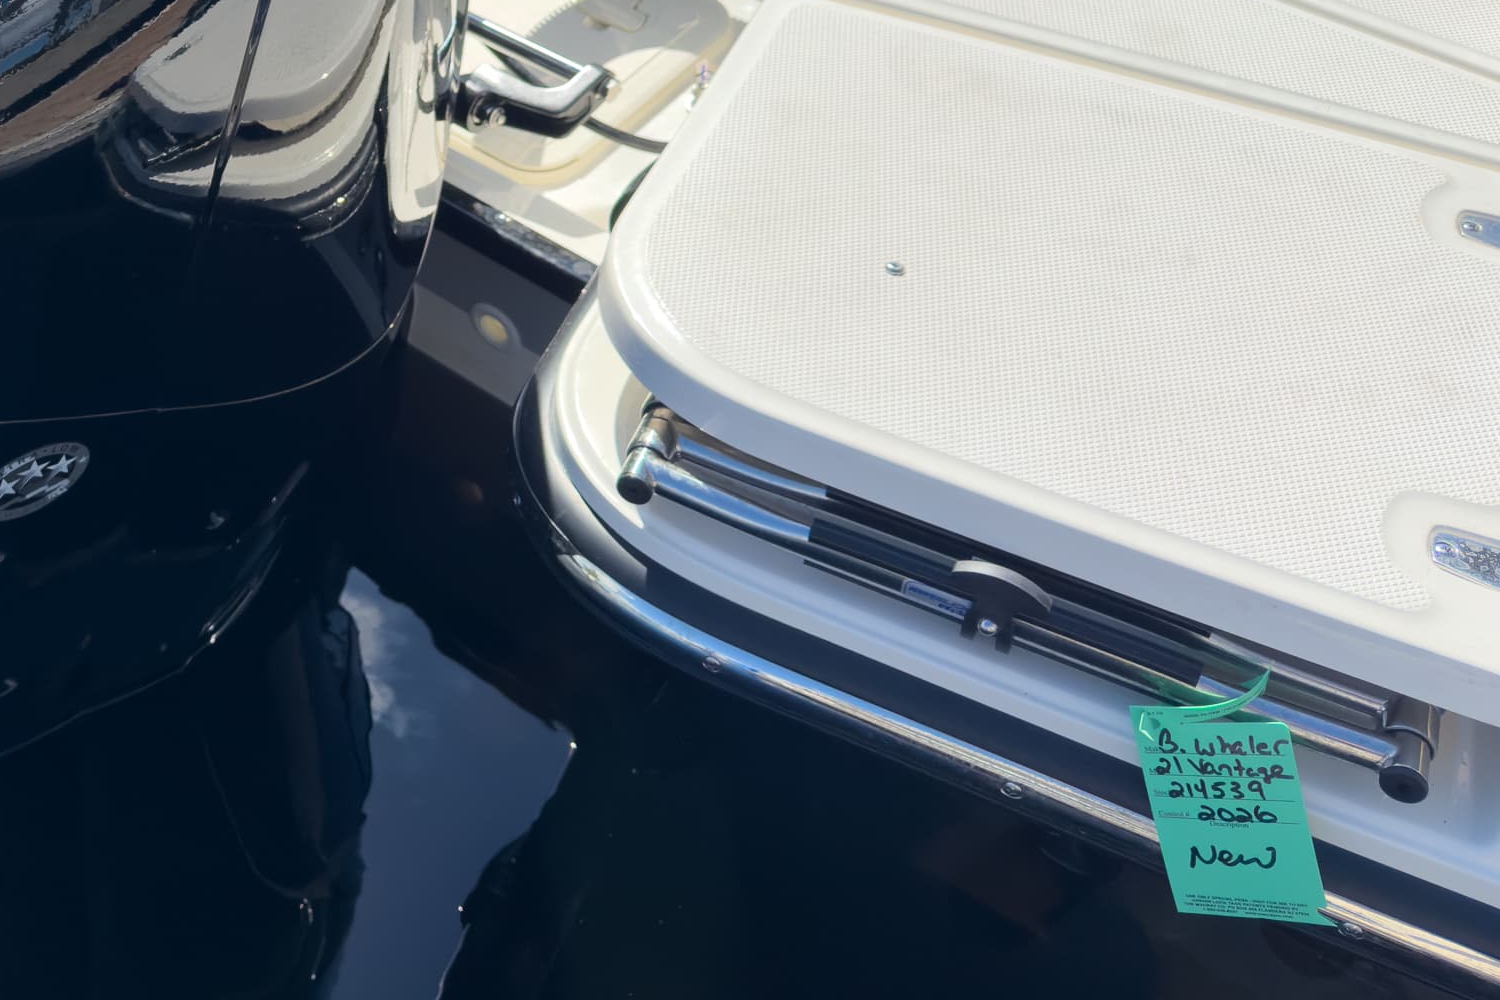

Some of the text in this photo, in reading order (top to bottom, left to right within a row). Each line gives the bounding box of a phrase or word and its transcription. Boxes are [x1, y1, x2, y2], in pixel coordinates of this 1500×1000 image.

[1155, 757, 1295, 784] 21 Vantage
[1168, 779, 1266, 801] 214539
[1197, 804, 1278, 823] 2026
[1189, 845, 1277, 869] New
